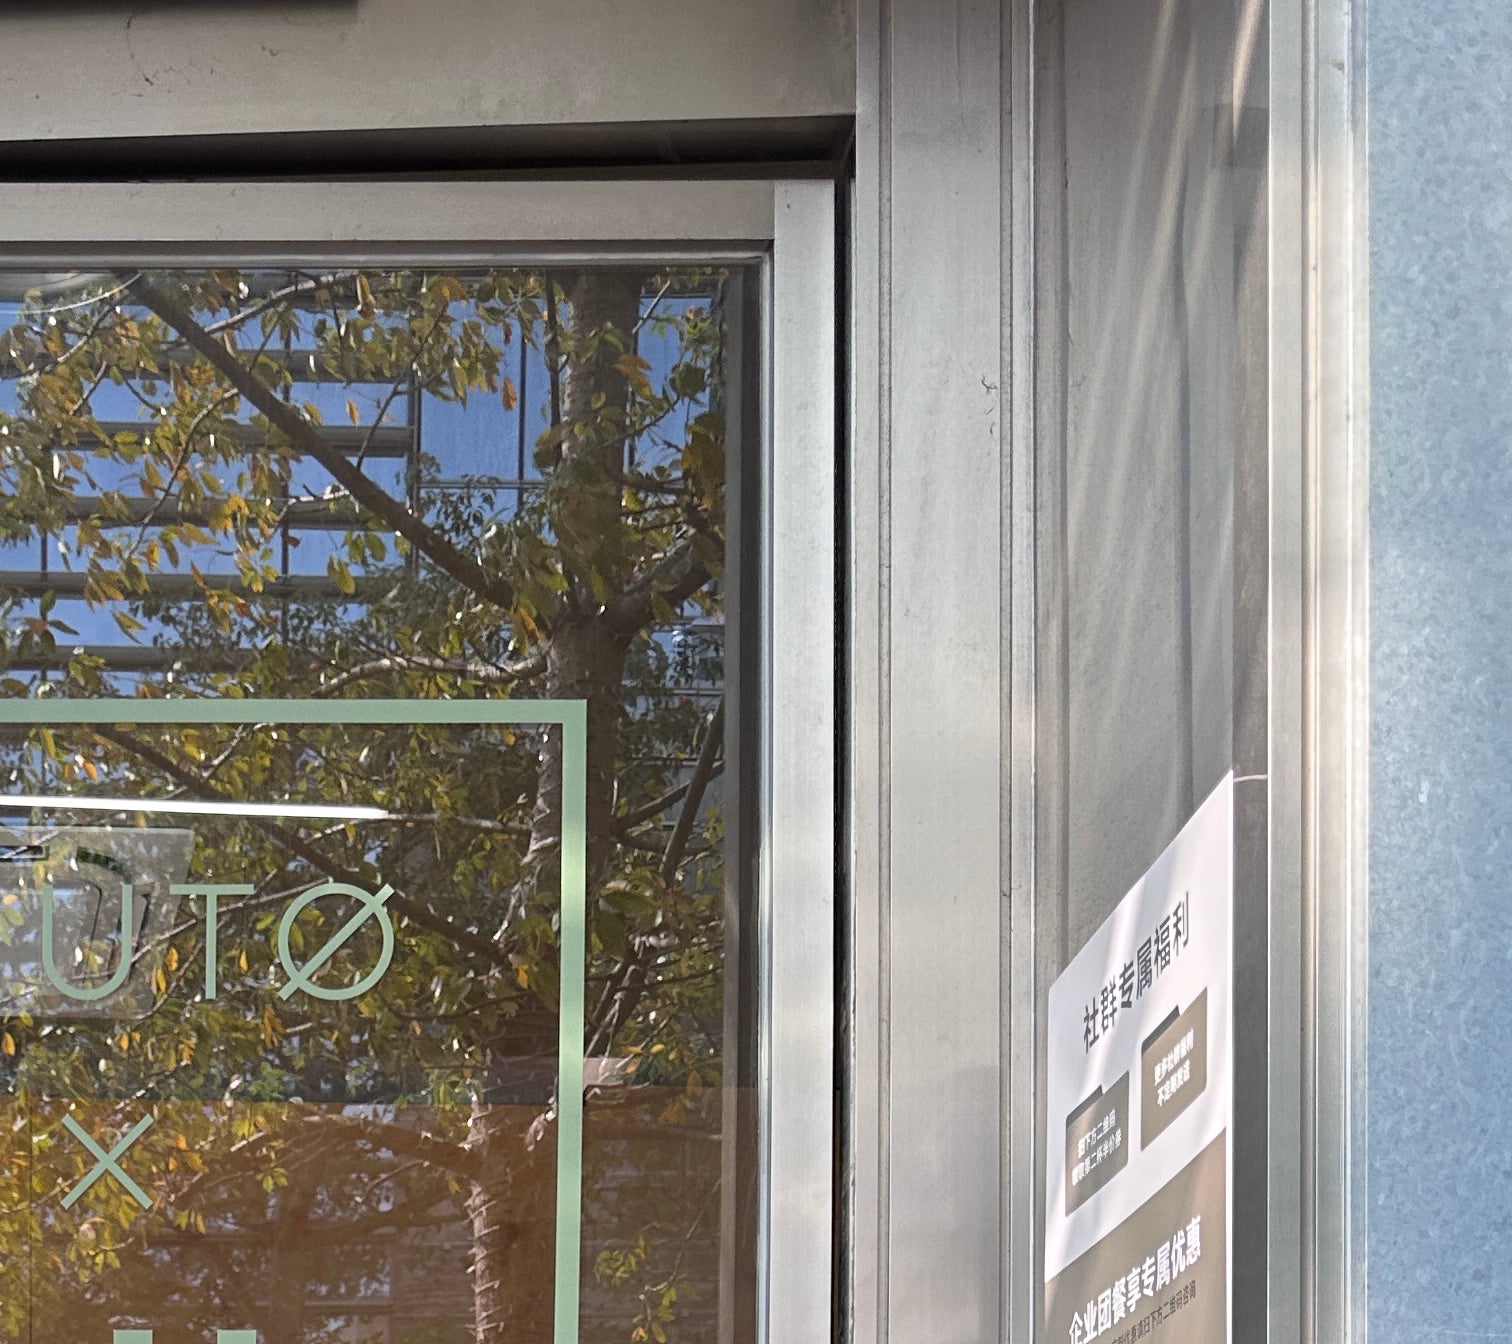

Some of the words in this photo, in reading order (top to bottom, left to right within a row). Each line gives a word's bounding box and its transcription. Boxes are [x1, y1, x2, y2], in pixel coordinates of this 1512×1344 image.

[1082, 890, 1190, 1054] 社群专属福利
